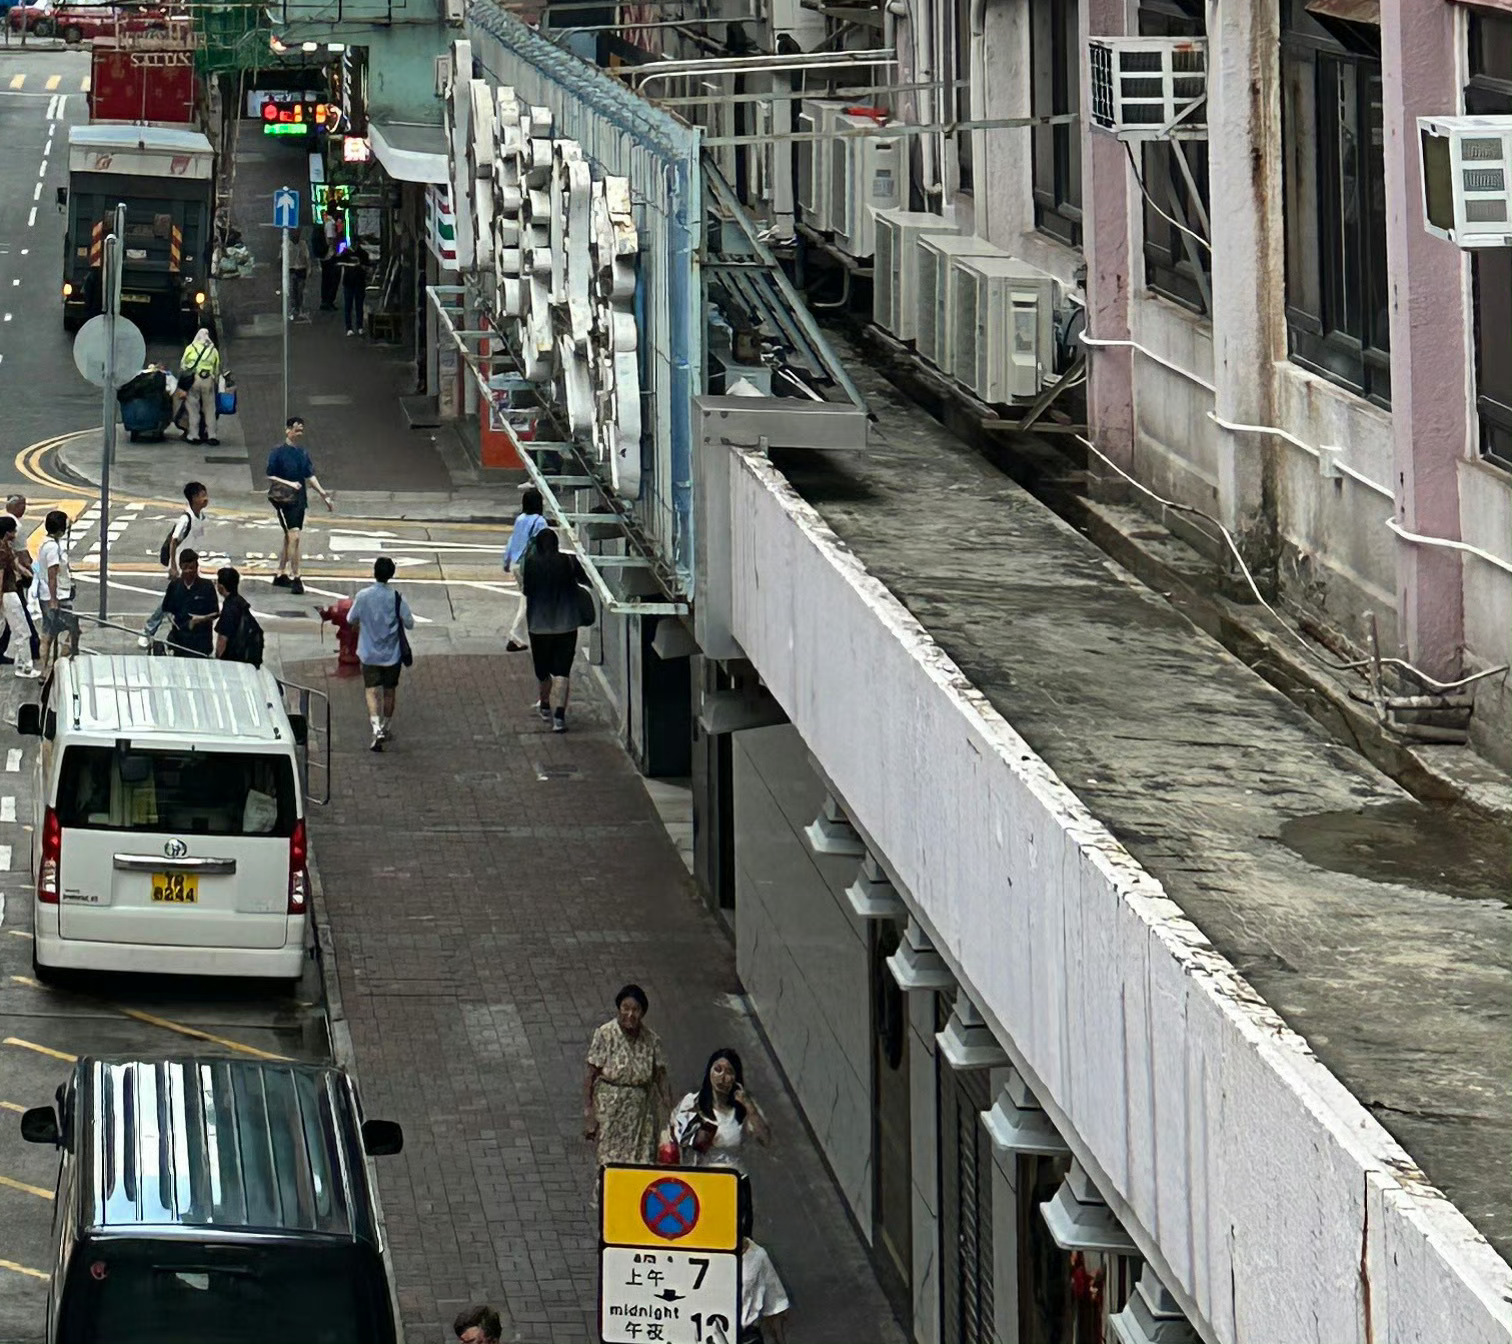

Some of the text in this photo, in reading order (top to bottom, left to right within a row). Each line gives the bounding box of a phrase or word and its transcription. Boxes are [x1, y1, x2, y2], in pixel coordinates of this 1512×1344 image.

[625, 1268, 665, 1288] 上午
[688, 1257, 710, 1290] 7
[609, 1303, 680, 1320] midnight
[625, 1321, 665, 1341] 午夜
